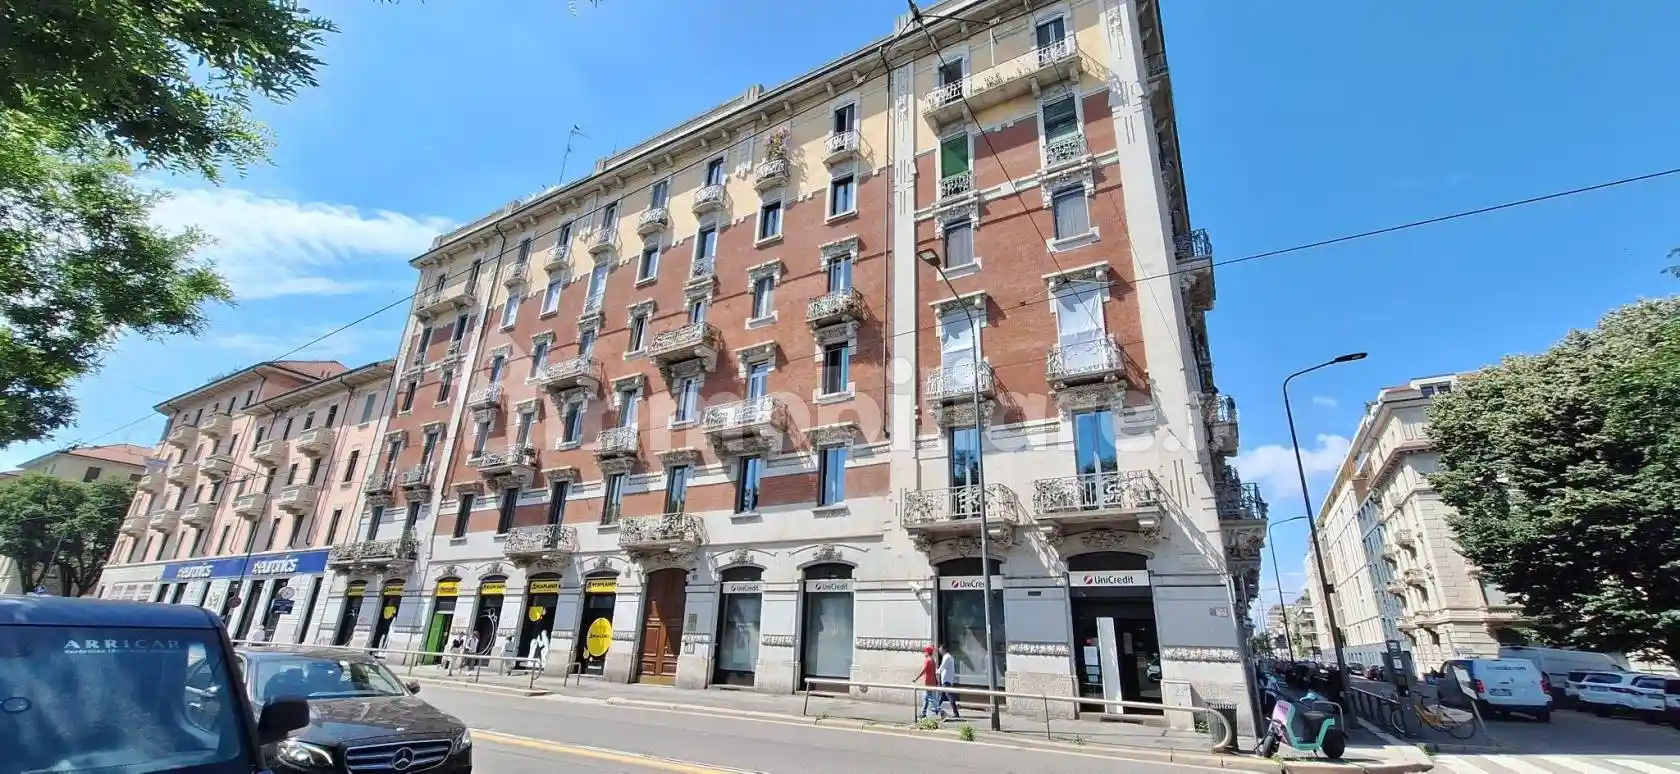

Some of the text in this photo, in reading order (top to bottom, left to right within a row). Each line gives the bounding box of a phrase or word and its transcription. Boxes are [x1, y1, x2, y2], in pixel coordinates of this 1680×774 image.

[960, 579, 985, 588] UniCre
[1095, 575, 1134, 585] UniCredit
[822, 583, 848, 591] UniCredit
[63, 639, 180, 649] ARRICAR
